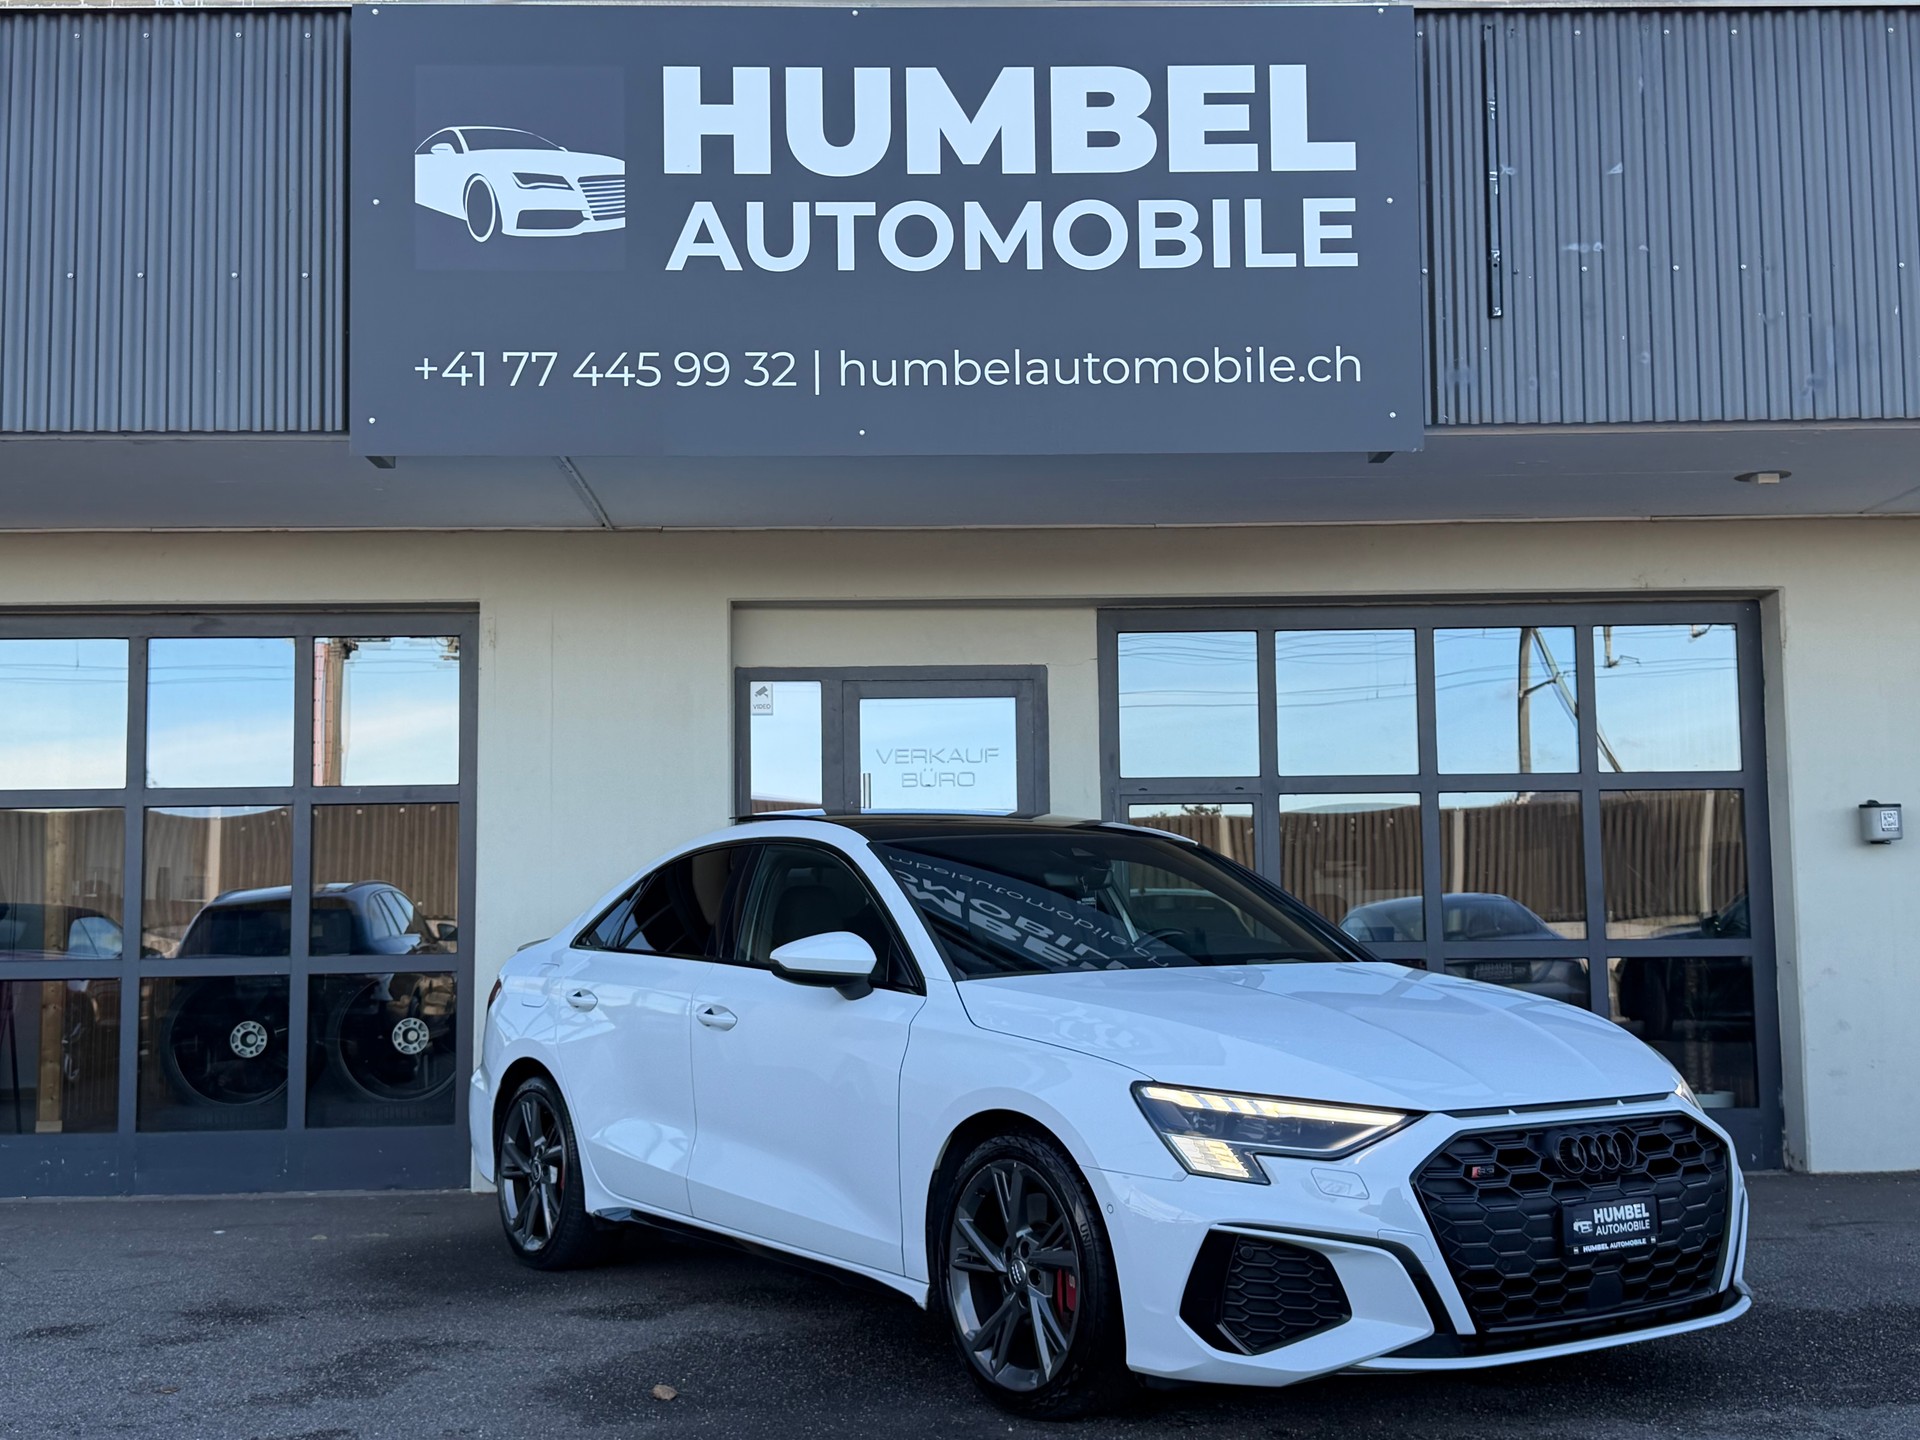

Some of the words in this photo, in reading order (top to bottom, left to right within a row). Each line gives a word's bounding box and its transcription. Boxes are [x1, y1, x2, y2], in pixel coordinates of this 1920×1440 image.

[662, 64, 1357, 176] HUMBEL
[664, 197, 1359, 272] AUTOMOBILE
[414, 351, 485, 387] +41
[502, 351, 558, 387] 77
[572, 351, 662, 387] 445
[673, 351, 730, 387] 99
[743, 351, 797, 387] 32
[840, 345, 1361, 387] humbelautomobile.ch
[876, 747, 1000, 765] VERKAUF
[901, 767, 976, 788] BÜRO
[1592, 1202, 1650, 1224] HUMBEL
[1595, 1219, 1651, 1237] AUTOMOBILE
[1582, 1242, 1610, 1253] HUMBEL
[1610, 1238, 1647, 1249] AUTOMOBILE
